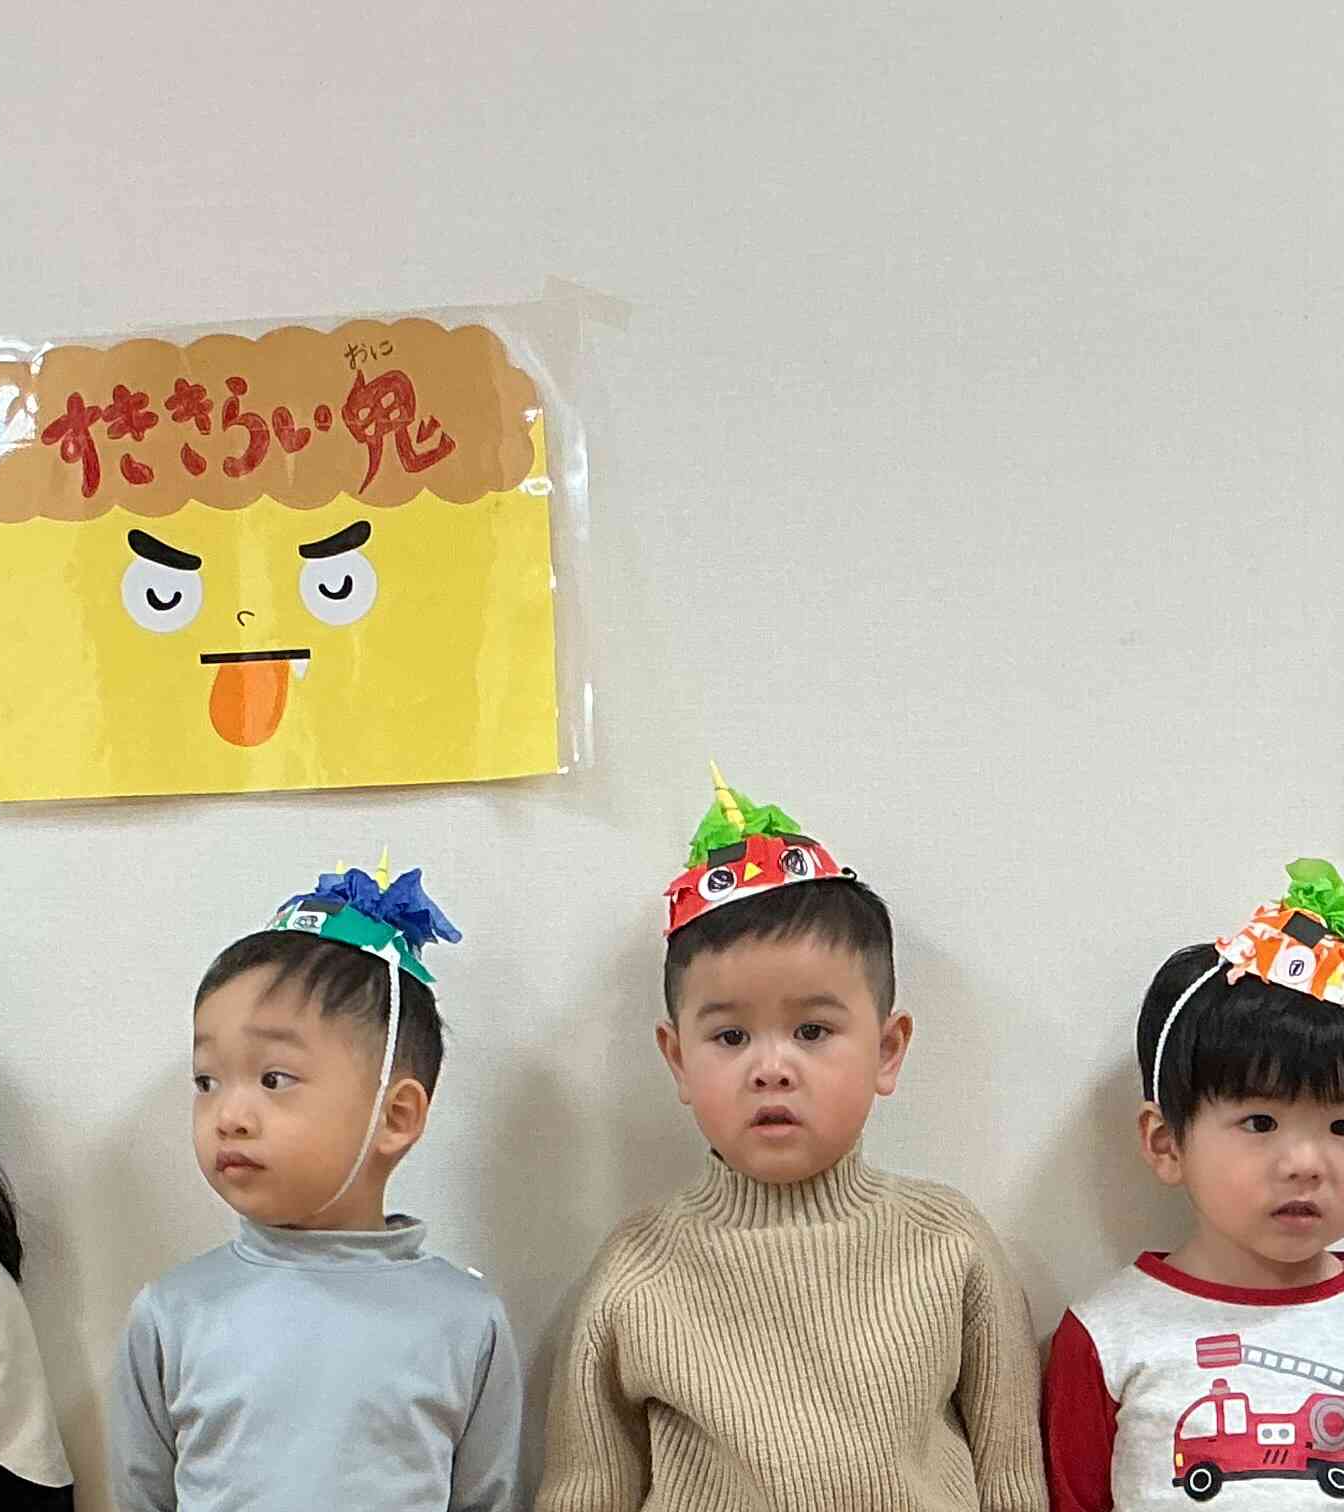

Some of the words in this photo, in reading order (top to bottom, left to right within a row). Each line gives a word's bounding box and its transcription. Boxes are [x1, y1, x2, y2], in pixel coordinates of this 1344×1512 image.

[344, 340, 394, 369] おに
[41, 369, 456, 498] すききらい鬼
